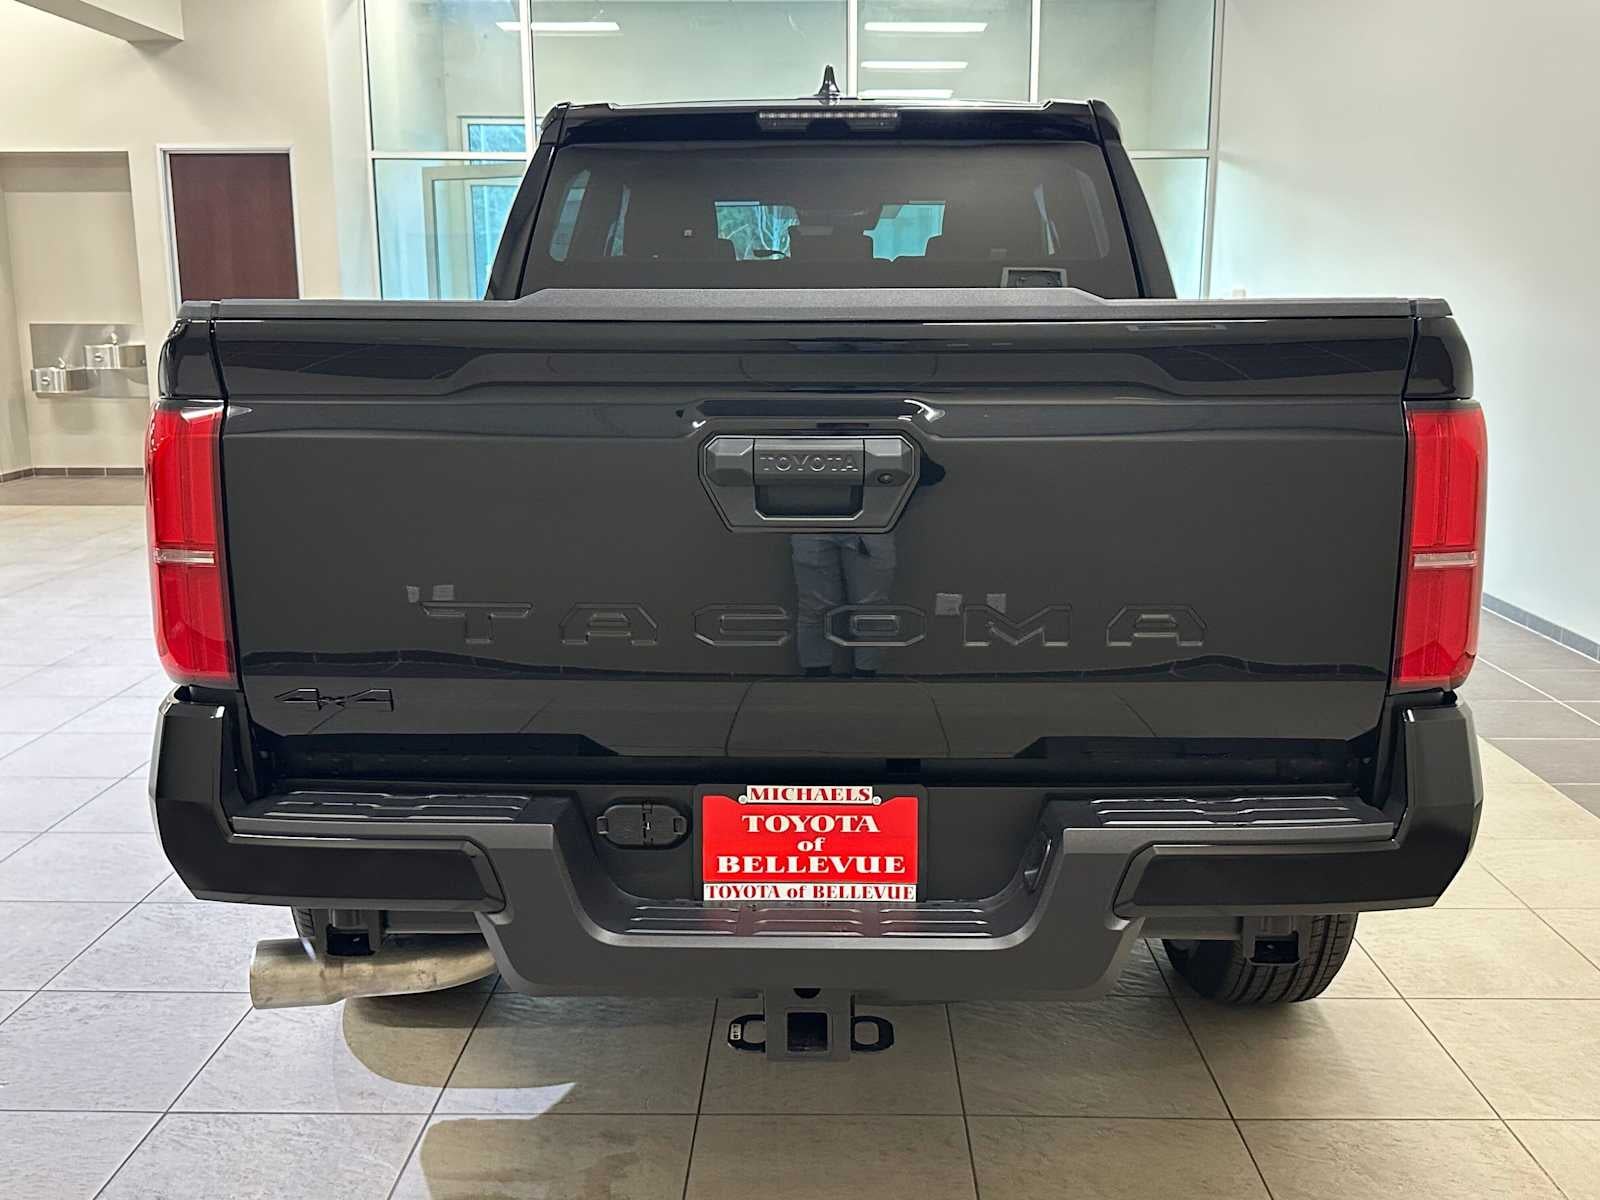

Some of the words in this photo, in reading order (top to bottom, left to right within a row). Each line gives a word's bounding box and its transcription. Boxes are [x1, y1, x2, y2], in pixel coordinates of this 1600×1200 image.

[759, 455, 859, 472] TOYOTA
[420, 602, 1208, 648] TACOMA
[749, 787, 871, 801] MICHAELS
[741, 815, 881, 833] TOYOTA
[796, 836, 826, 852] of
[716, 855, 906, 874] BELLEVUE
[705, 885, 780, 899] TOYOTA
[787, 885, 805, 899] of
[812, 885, 915, 900] BELLEVUE
